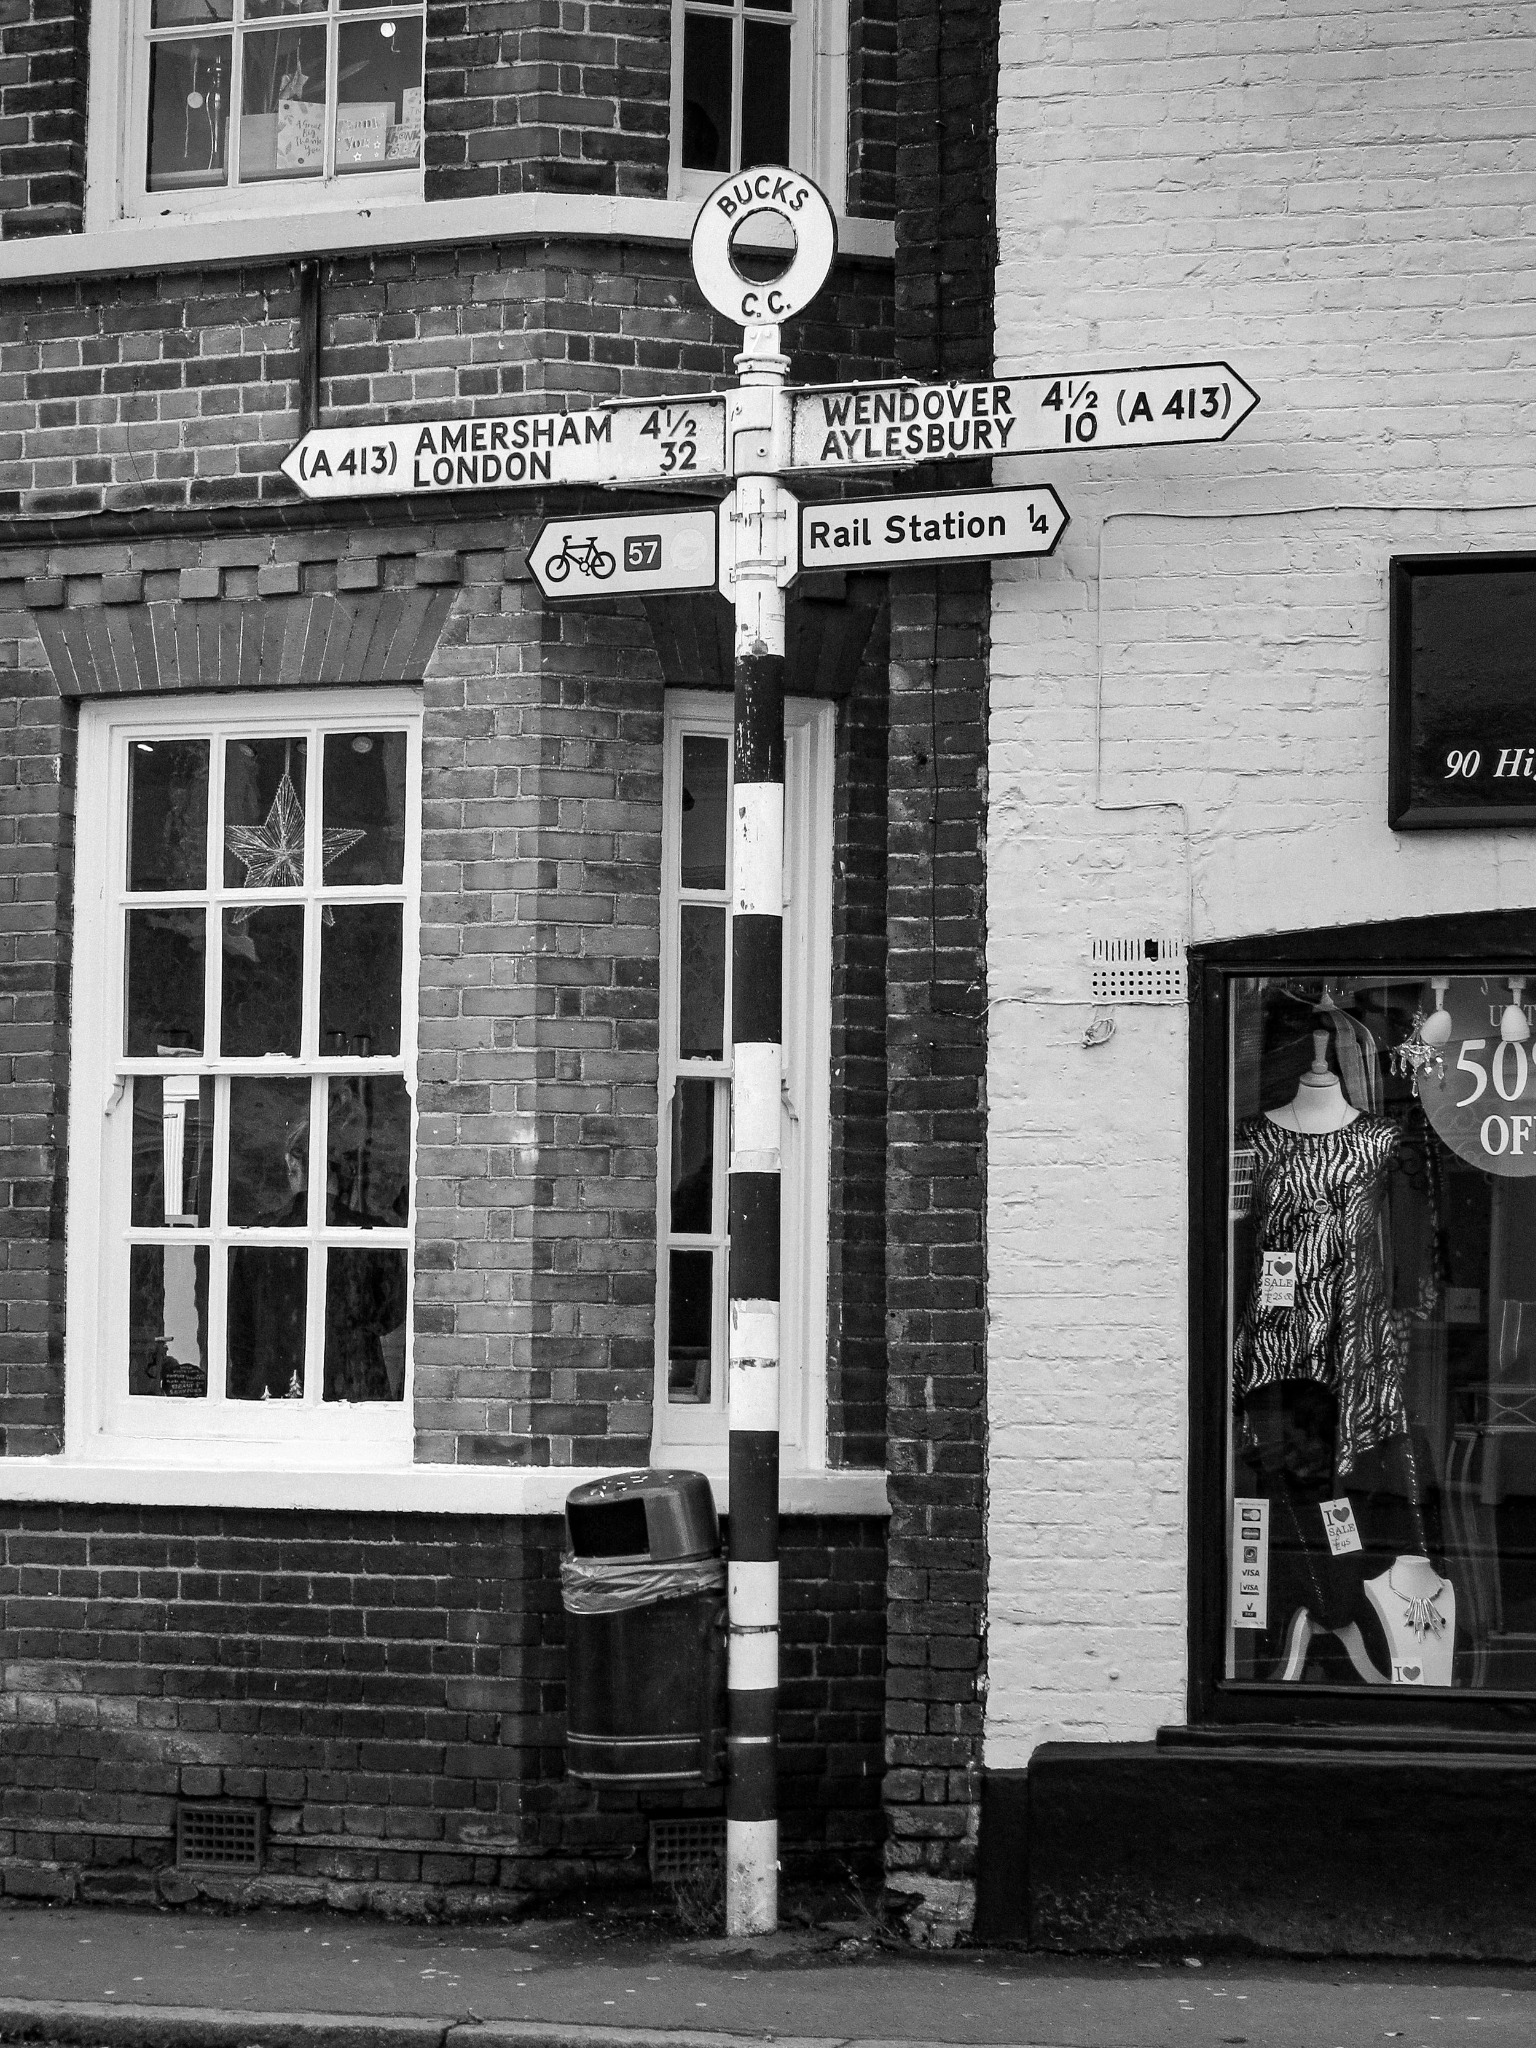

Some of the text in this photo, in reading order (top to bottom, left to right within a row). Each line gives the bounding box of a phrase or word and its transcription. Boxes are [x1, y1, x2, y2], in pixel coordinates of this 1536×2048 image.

[716, 175, 809, 219] BUCKS
[822, 385, 1013, 427] WENDOVER
[414, 413, 612, 457] AMERSHAM
[820, 411, 1098, 461] AYLESBURY 10
[414, 440, 697, 487] LONDON 32
[810, 517, 872, 549] Rail
[884, 510, 1006, 544] Station
[628, 541, 658, 565] 57
[1444, 748, 1536, 782] 90 Hi
[1456, 1039, 1536, 1108] 50
[1481, 1114, 1536, 1156] OF
[1264, 1278, 1293, 1287] SALE
[1329, 1523, 1356, 1537] SALE
[1242, 1569, 1260, 1577] VISA
